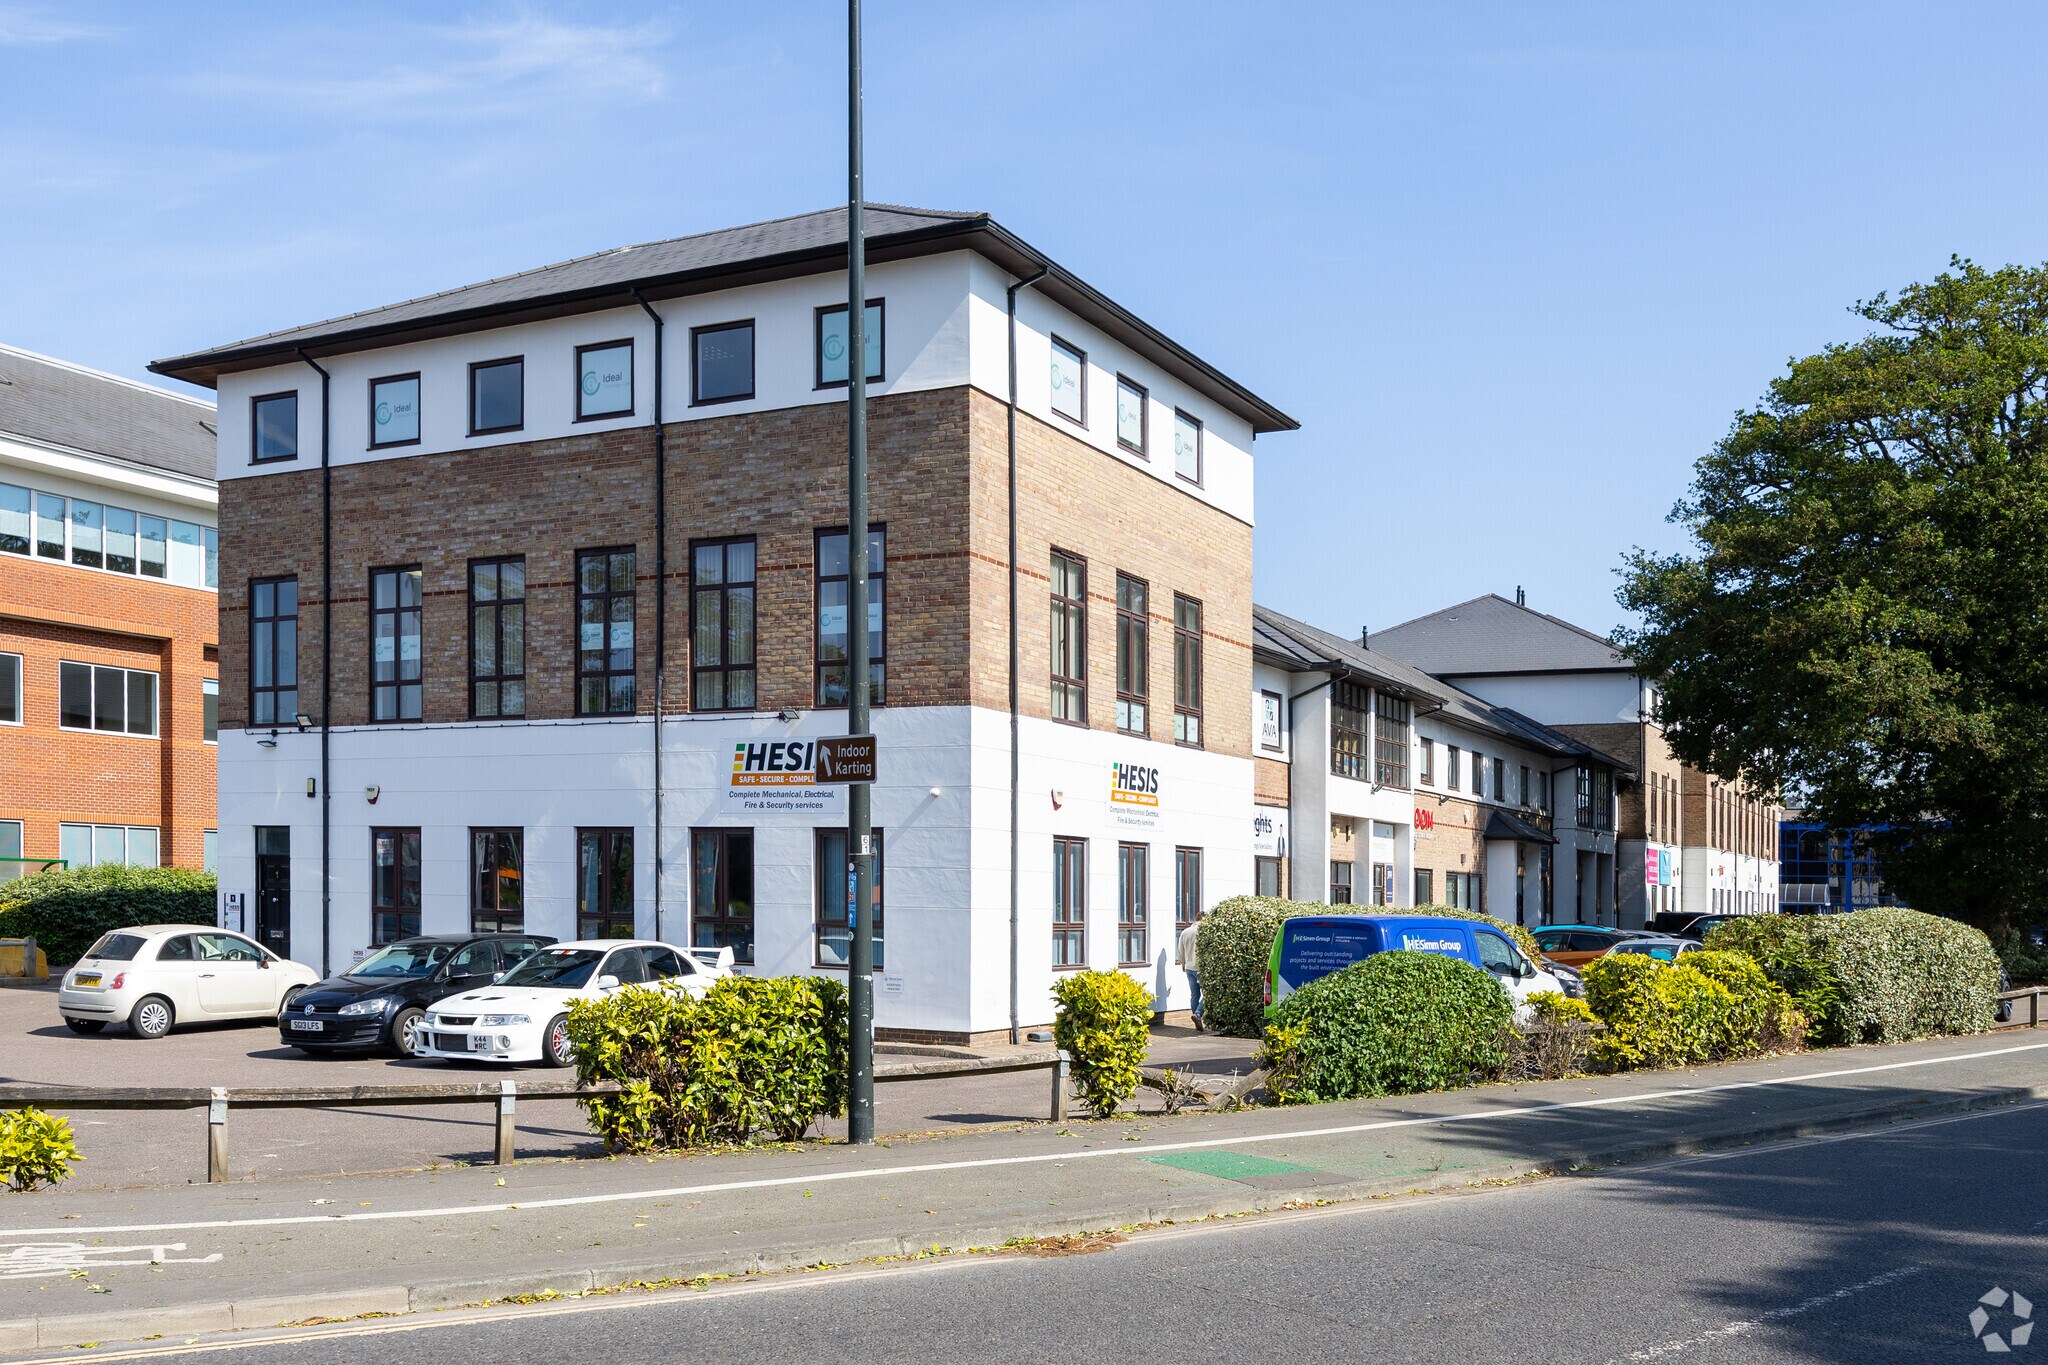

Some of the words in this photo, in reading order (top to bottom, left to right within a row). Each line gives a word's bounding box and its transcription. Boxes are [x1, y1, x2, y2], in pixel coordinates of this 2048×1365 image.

[602, 371, 623, 384] Ideal
[393, 402, 412, 413] Ideal
[1262, 722, 1277, 739] AVA
[745, 742, 815, 771] HESI
[837, 744, 870, 758] Indoor
[835, 761, 872, 776] Karting
[1118, 763, 1159, 794] HESIS
[729, 791, 761, 799] Complete
[762, 791, 803, 799] Mechanical,
[744, 801, 757, 809] Fire
[766, 801, 794, 810] Security
[1254, 812, 1272, 837] ghts
[863, 836, 869, 844] 6
[1440, 940, 1461, 953] Group
[1301, 950, 1323, 958] Delivering
[307, 1022, 320, 1030] LFS
